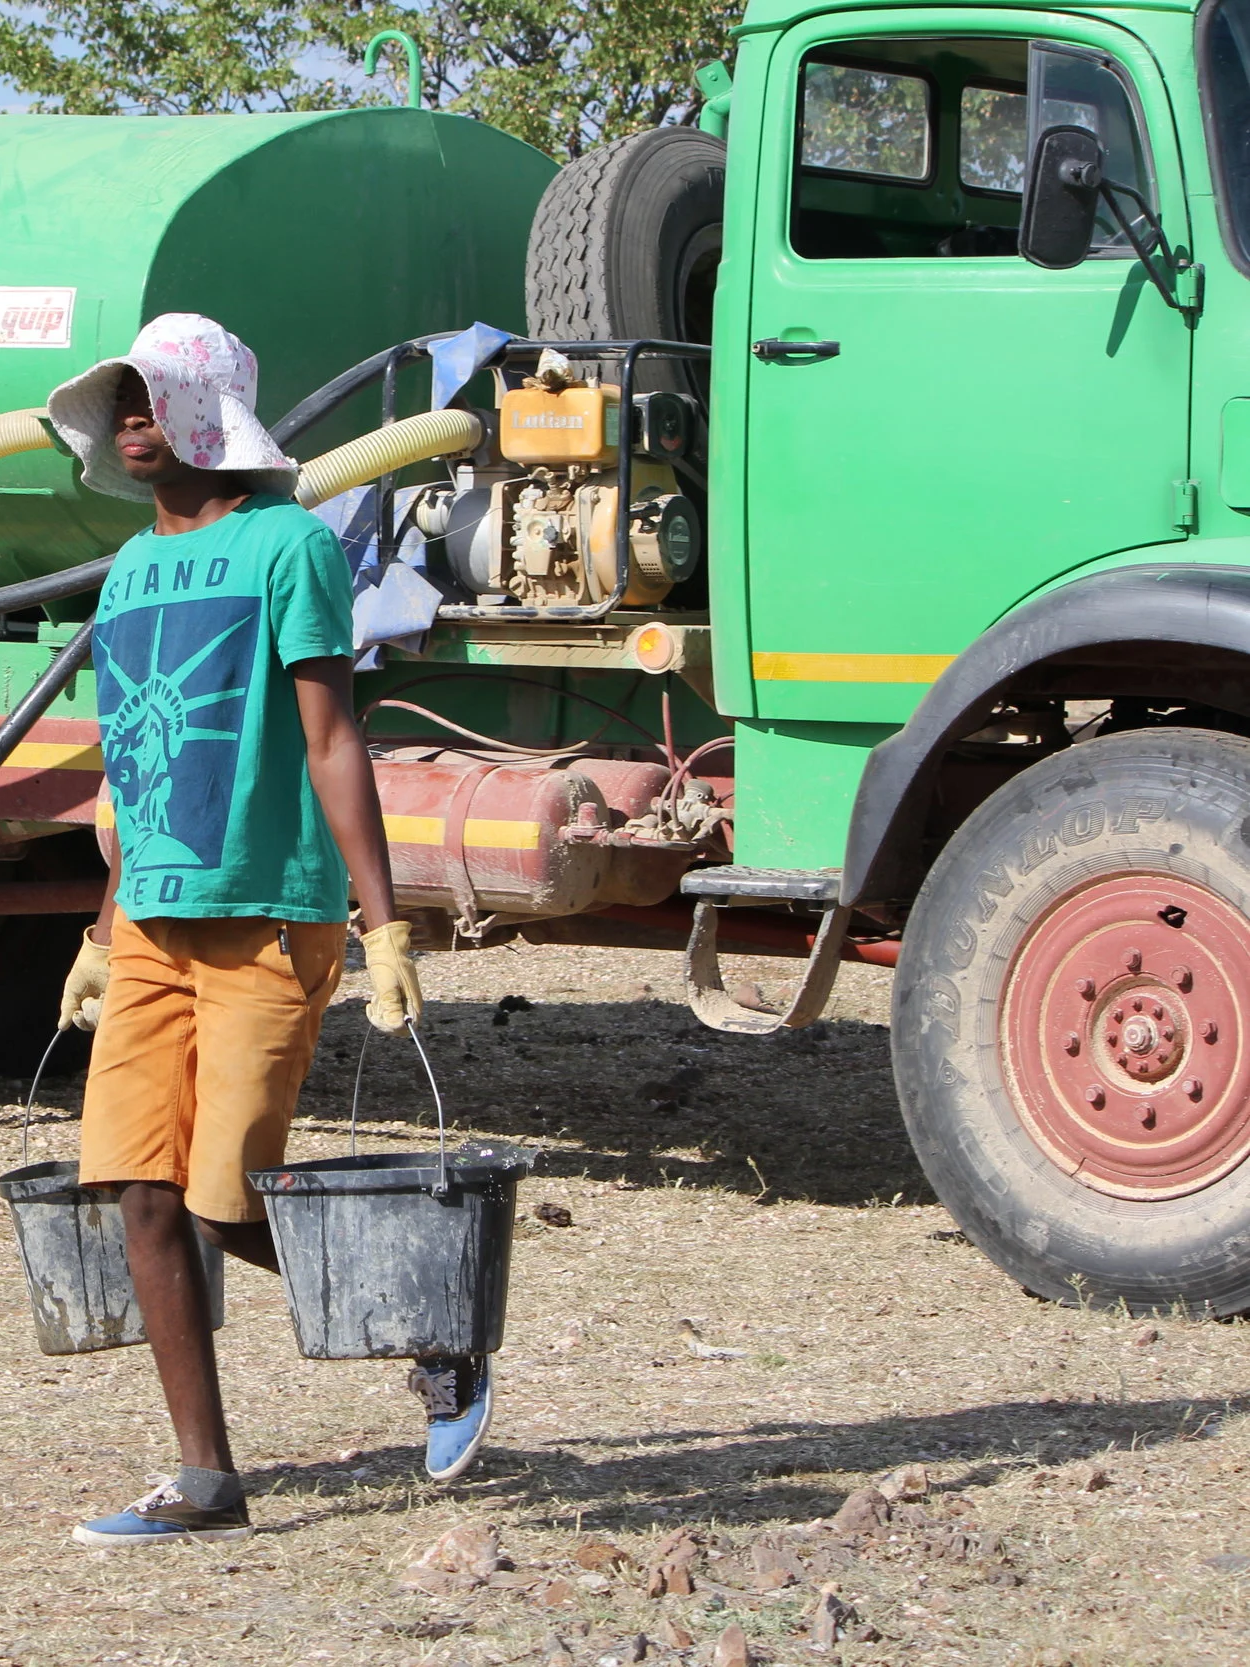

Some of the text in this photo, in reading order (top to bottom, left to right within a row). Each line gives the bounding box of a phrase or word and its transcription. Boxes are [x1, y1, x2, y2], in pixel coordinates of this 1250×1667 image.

[511, 409, 583, 429] Lutian
[104, 557, 230, 612] STAND
[928, 796, 1168, 1041] DUNLOP
